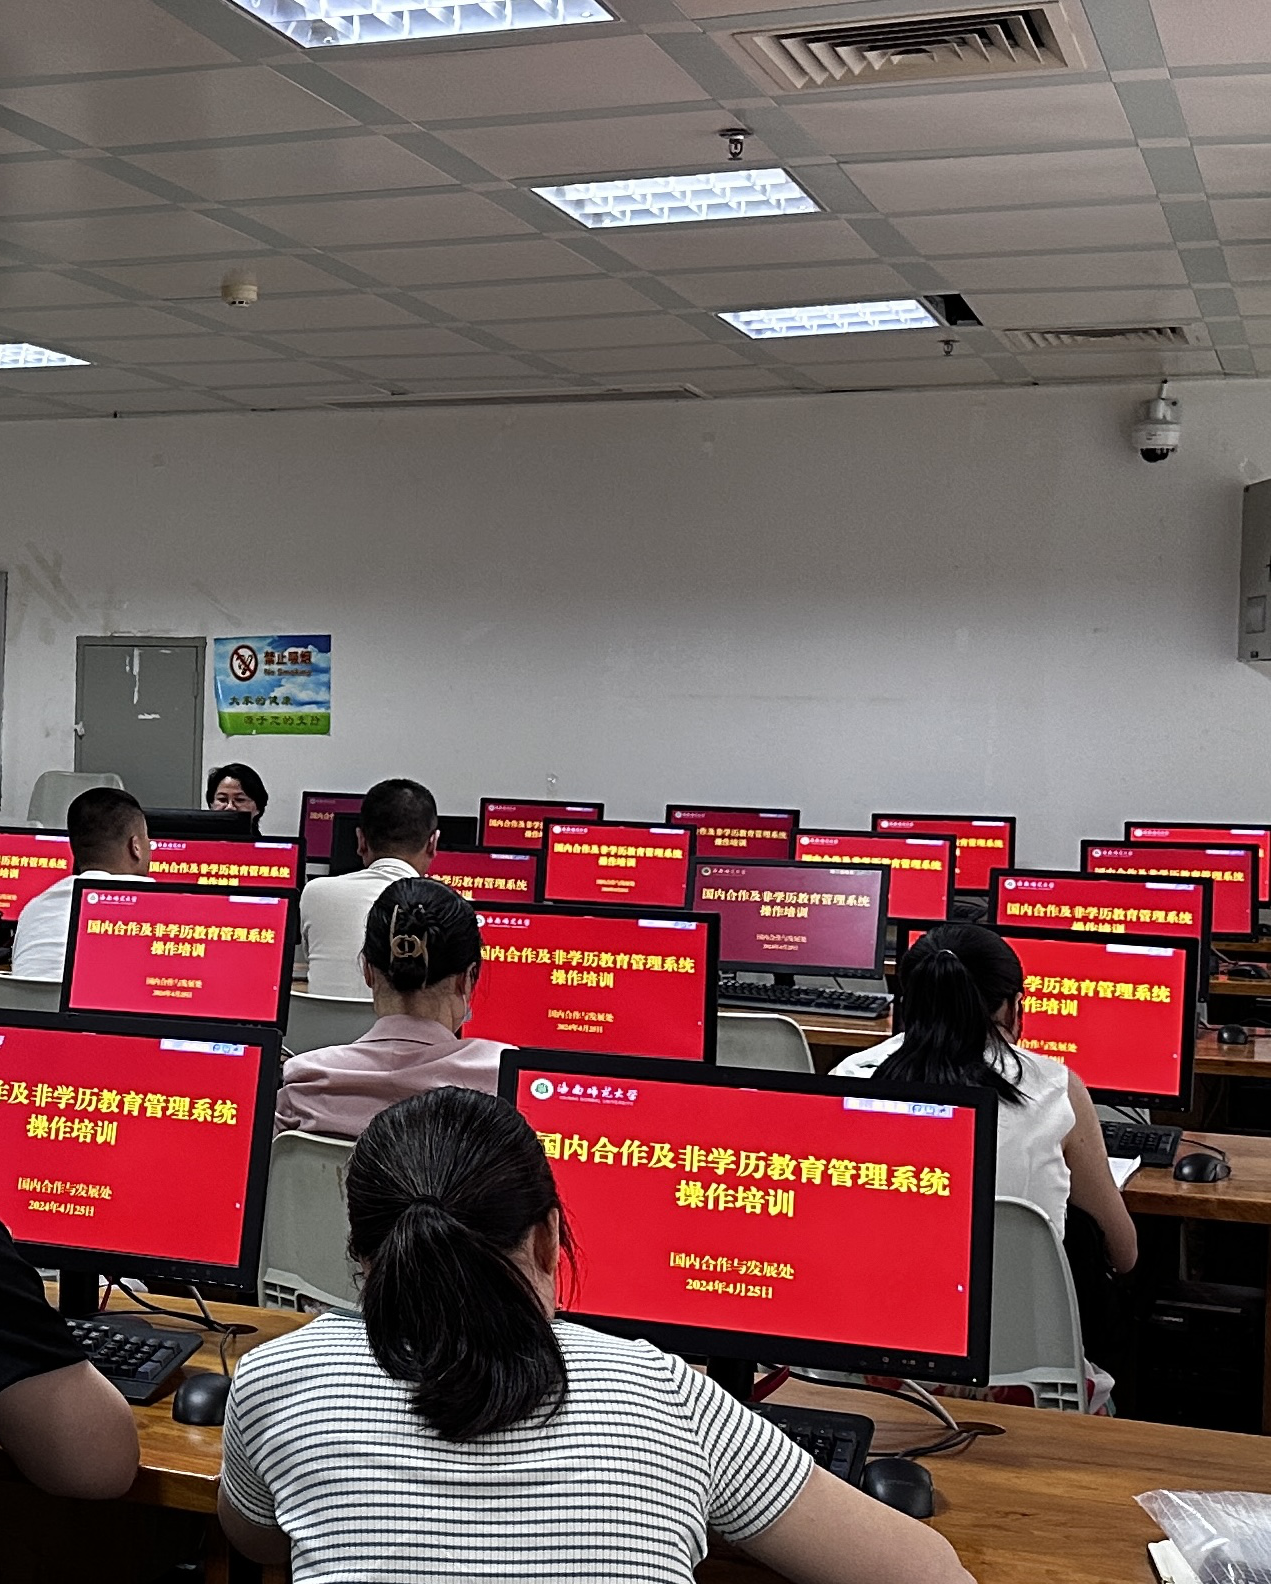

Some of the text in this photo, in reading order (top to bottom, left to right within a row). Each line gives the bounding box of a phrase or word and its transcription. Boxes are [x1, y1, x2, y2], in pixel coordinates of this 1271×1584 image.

[264, 650, 312, 665] 禁止吸烟
[549, 967, 615, 989] 操作培训
[26, 1113, 119, 1146] 操作培训
[535, 1130, 951, 1197] 国内合作及非学历教育管理系统
[17, 1176, 113, 1201] 国内合作与发展处
[674, 1178, 797, 1218] 操作培训
[668, 1250, 796, 1282] 国内合作与发展处
[684, 1277, 775, 1300] 2024年4月25日
